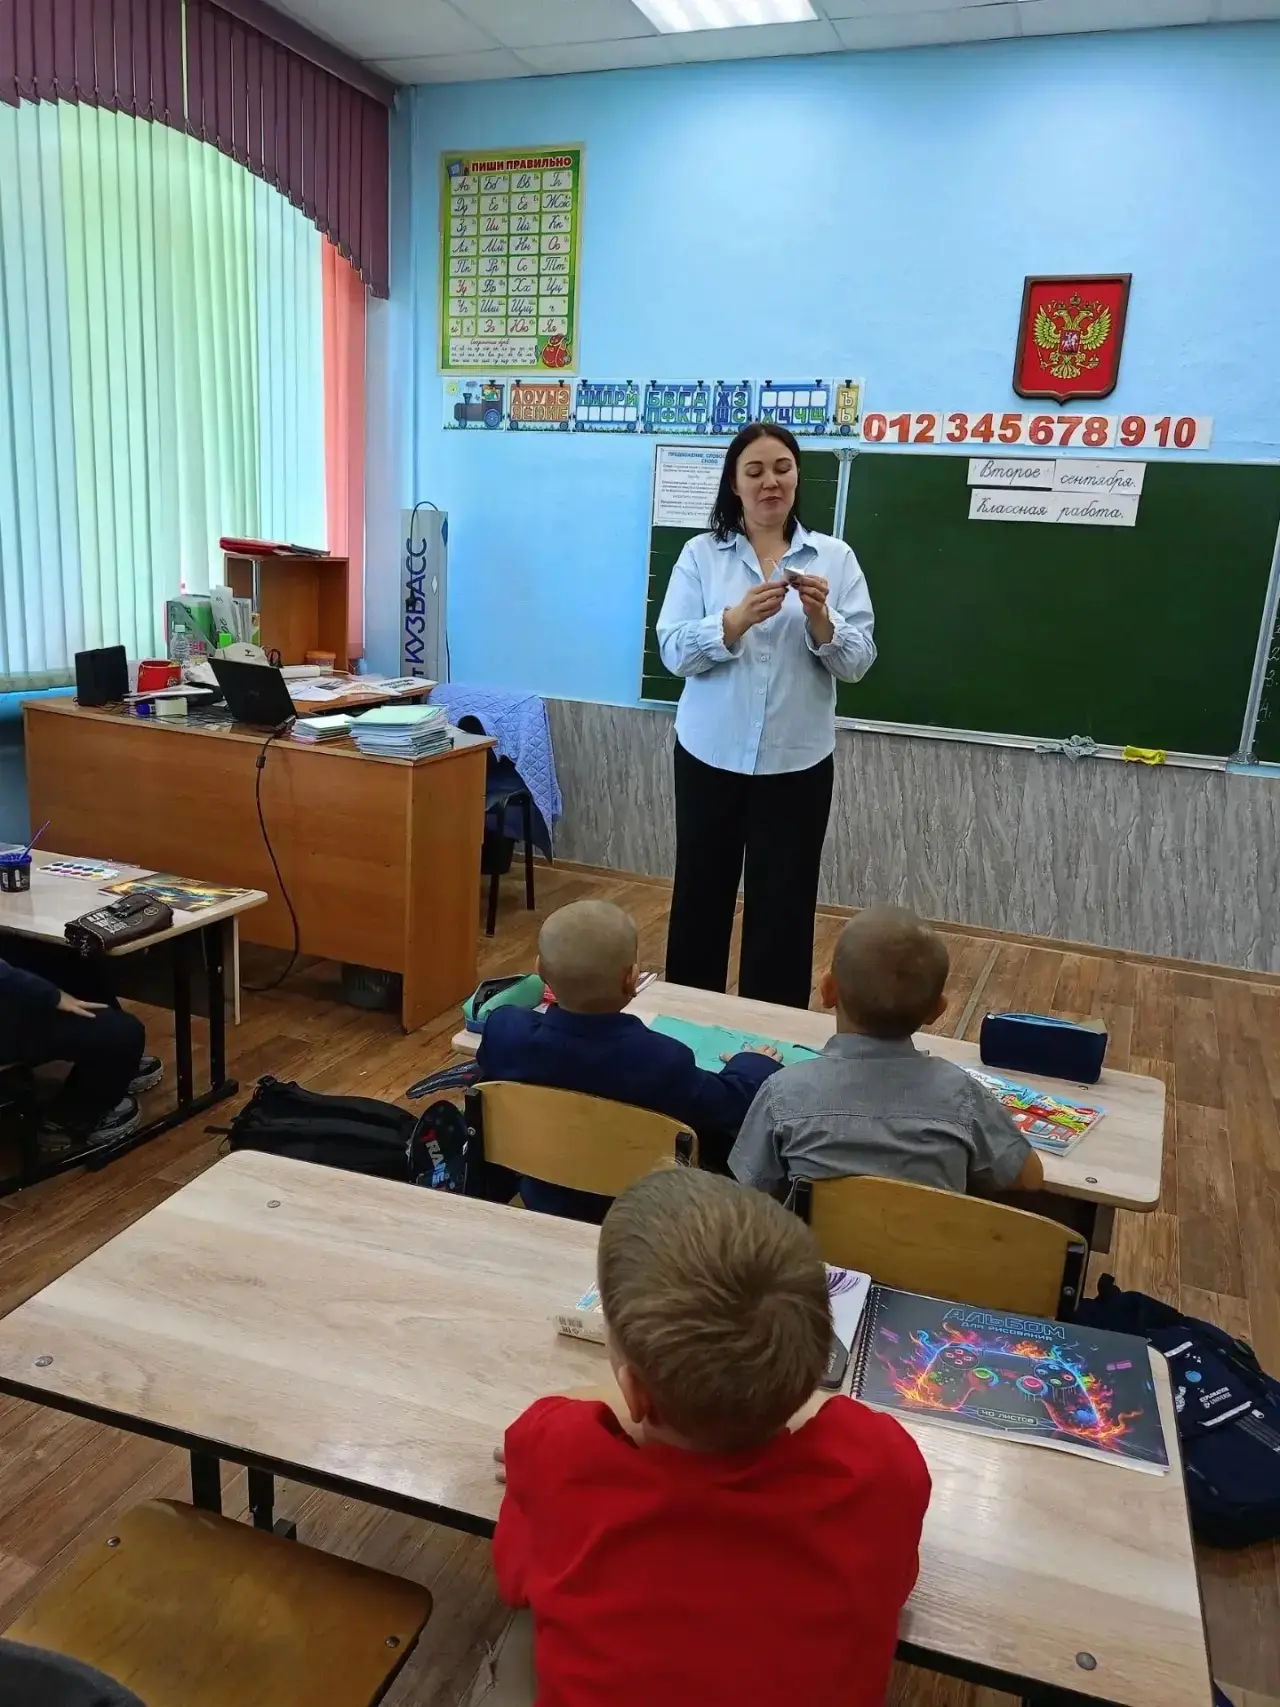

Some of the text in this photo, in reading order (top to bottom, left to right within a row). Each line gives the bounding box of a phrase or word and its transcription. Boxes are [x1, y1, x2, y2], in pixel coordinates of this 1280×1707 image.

[472, 157, 572, 172] ПИШИ ПРАВИЛЬНО
[979, 459, 1041, 484] Второе
[976, 496, 1125, 522] Классная работа.
[405, 537, 428, 664] КУЗБАСС
[943, 1308, 1065, 1340] АЛЬБОМ
[988, 1326, 1053, 1341] РИСОВАНИЯ
[981, 1409, 1035, 1425] 40 ЛИСТОВ
